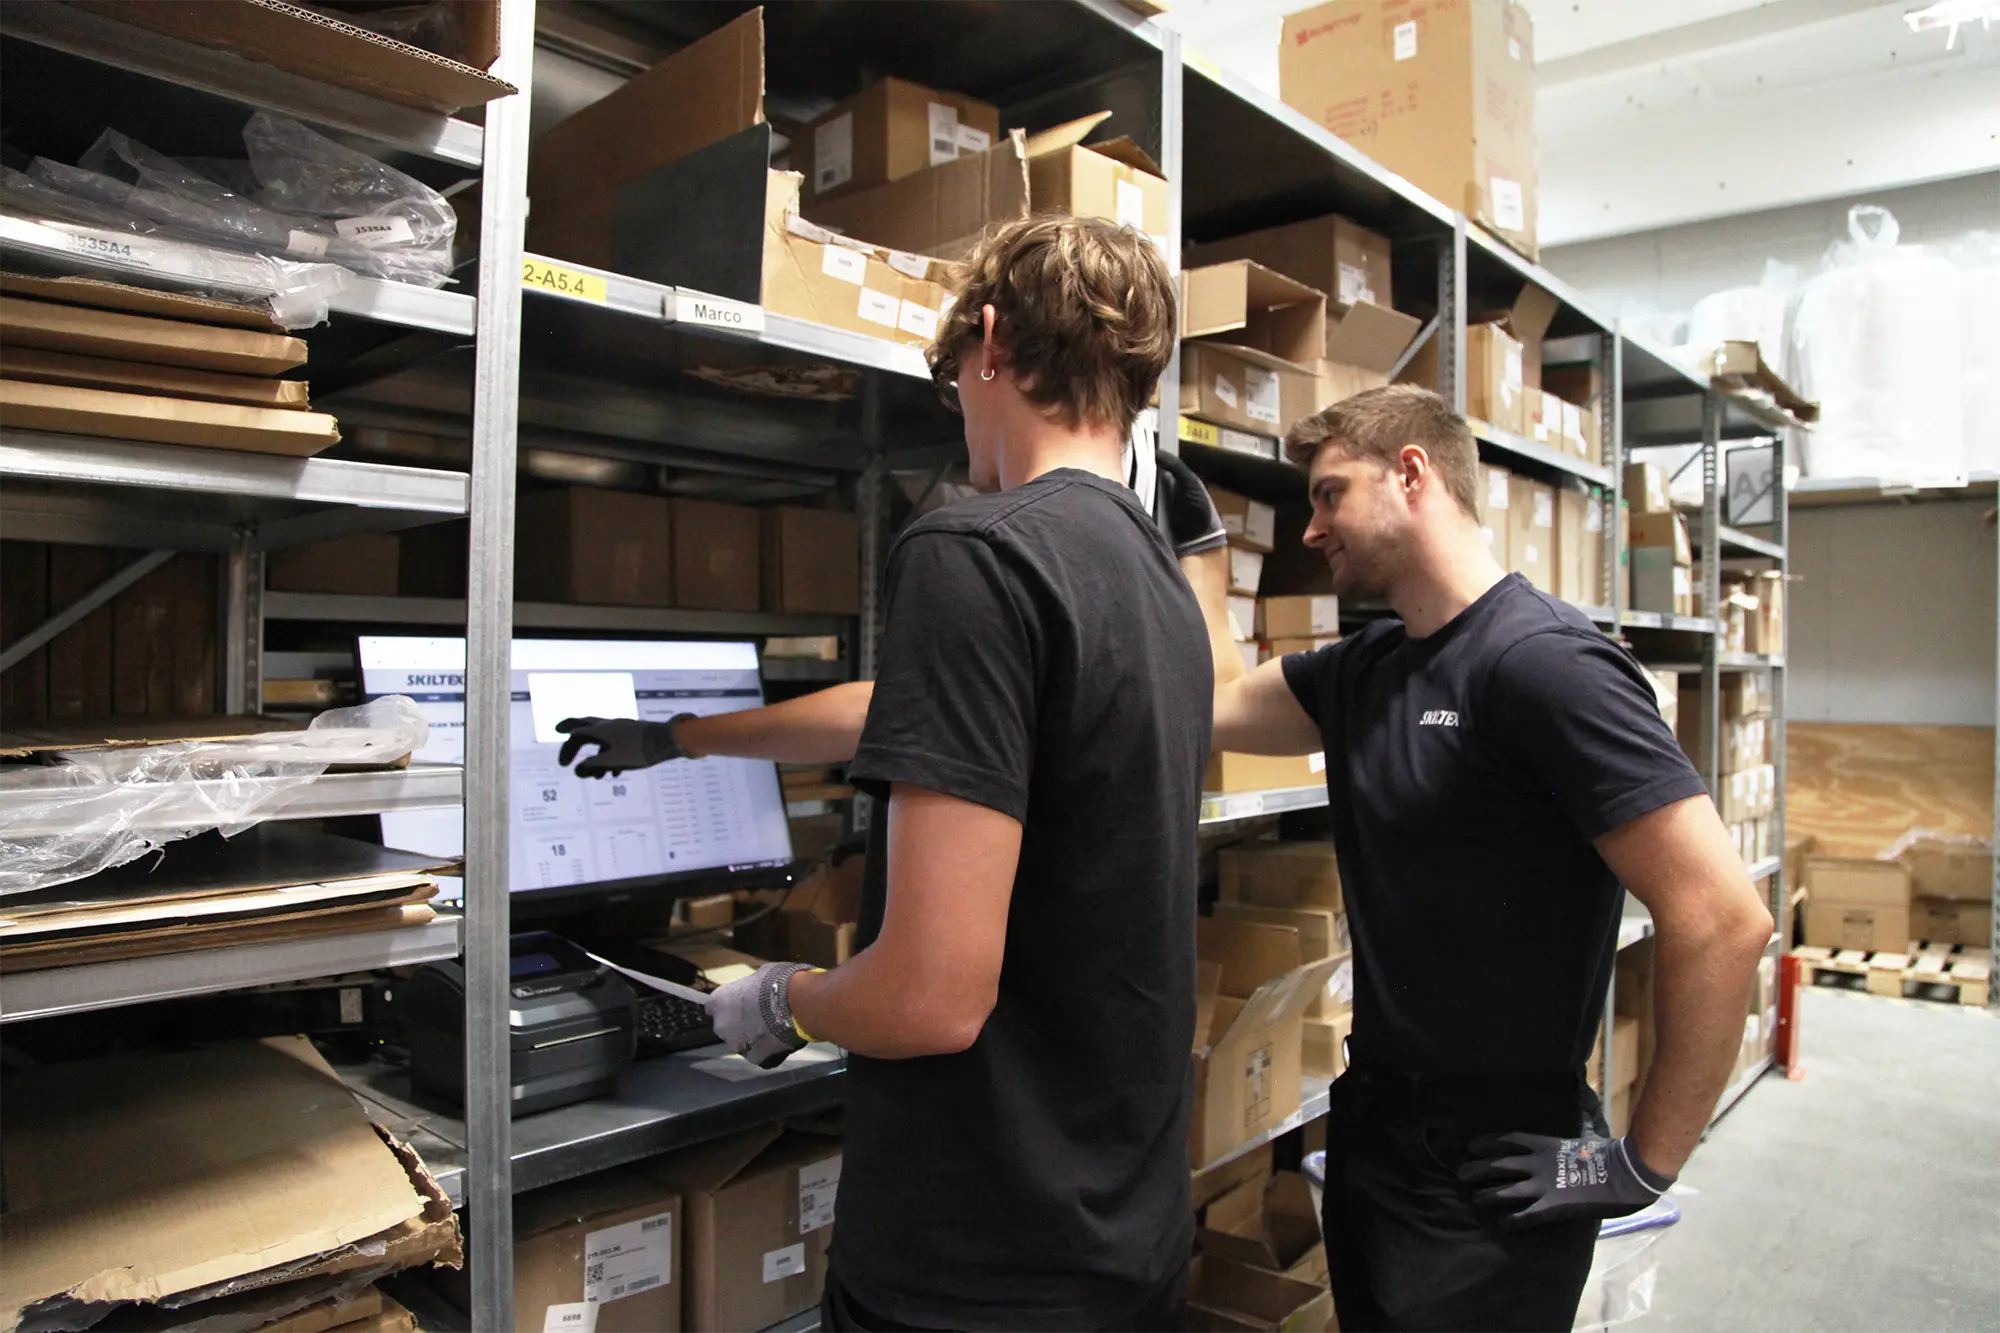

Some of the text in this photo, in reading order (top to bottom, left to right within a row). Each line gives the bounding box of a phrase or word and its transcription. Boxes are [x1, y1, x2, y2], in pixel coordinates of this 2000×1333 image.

[66, 232, 132, 256] 3535A4
[523, 264, 585, 295] 2-A5.4
[694, 303, 742, 323] Marco
[542, 789, 558, 802] 52
[551, 844, 567, 856] 18
